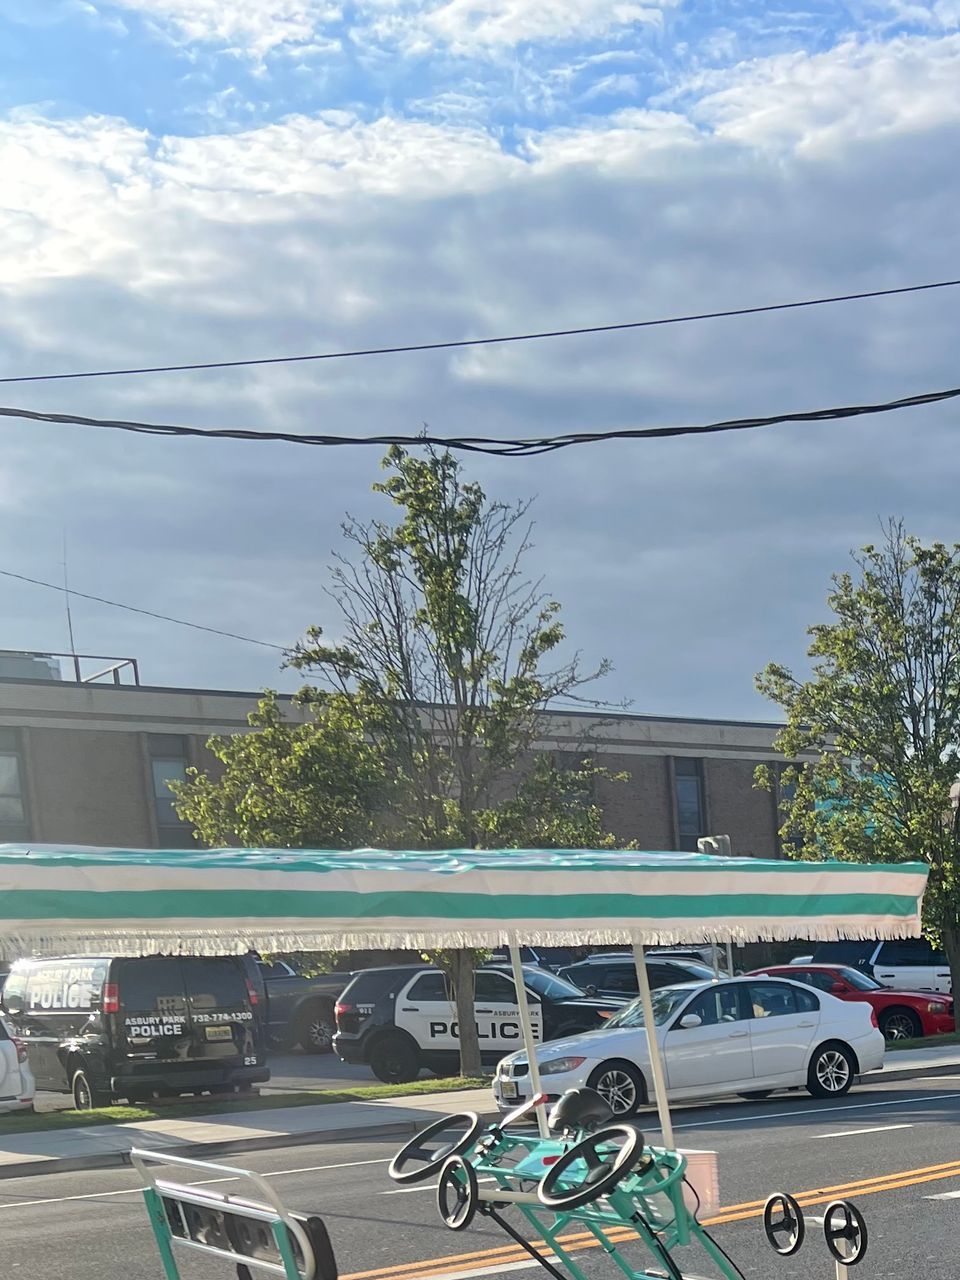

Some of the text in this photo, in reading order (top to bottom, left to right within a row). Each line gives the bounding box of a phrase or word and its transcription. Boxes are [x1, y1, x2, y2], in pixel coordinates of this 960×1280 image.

[30, 984, 92, 1009] POLICE
[125, 1015, 186, 1026] ASBURY PARK
[192, 1012, 253, 1023] 732-774-1300
[131, 1025, 182, 1037] POLICE
[244, 1056, 257, 1066] 25
